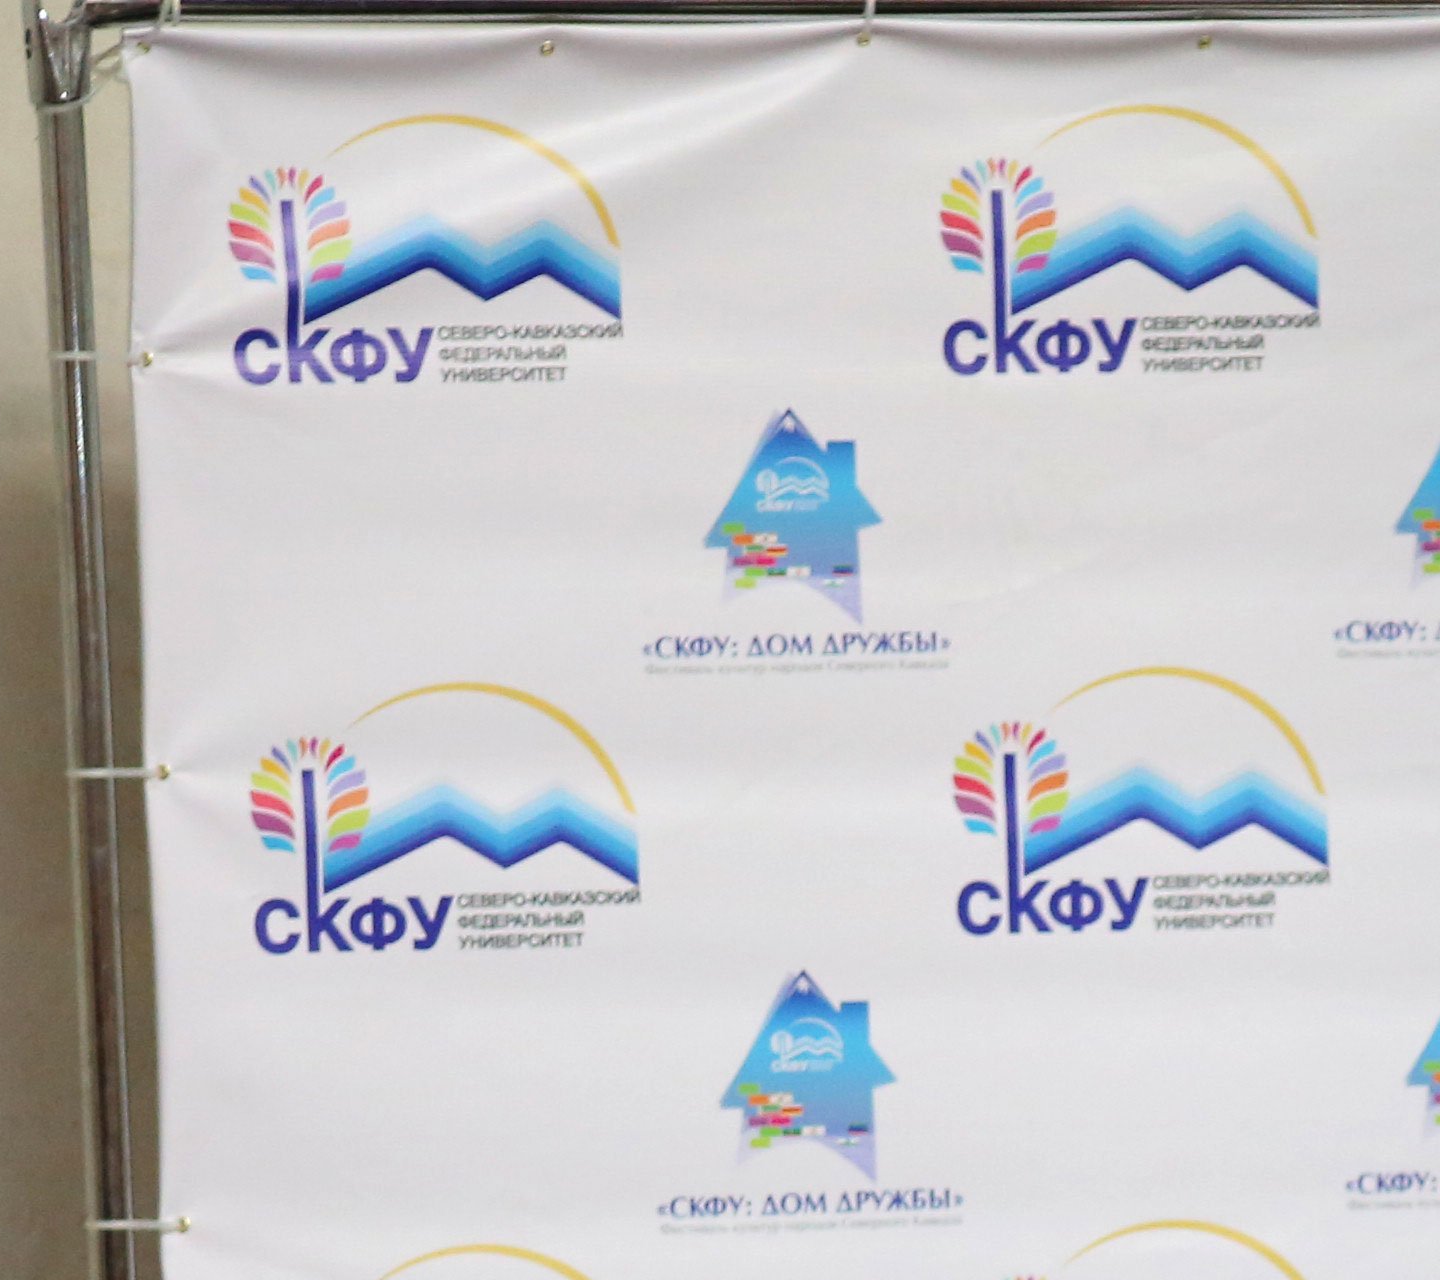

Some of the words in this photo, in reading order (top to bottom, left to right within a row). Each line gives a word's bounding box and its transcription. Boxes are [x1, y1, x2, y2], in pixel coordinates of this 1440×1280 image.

[234, 327, 435, 385] СКФУ
[437, 342, 568, 363] ФЕДЕРАЛЬНЫЙ
[942, 318, 1138, 377] СКФУ
[439, 363, 567, 383] УНИВЕРСИТЕТ
[746, 633, 815, 659] ДОМ
[956, 877, 1149, 938] СКФУ
[1151, 888, 1277, 911] ФЕДЕРАЛЬНЫЙ
[254, 894, 454, 957] СКФУ
[455, 907, 586, 931] ФЕДЕРАЛЬНЫЙ
[1152, 909, 1276, 931] УНИВЕРСИТЕТ
[457, 928, 585, 951] УНИВЕРСИТЕТ
[761, 1191, 828, 1218] ДОМ
